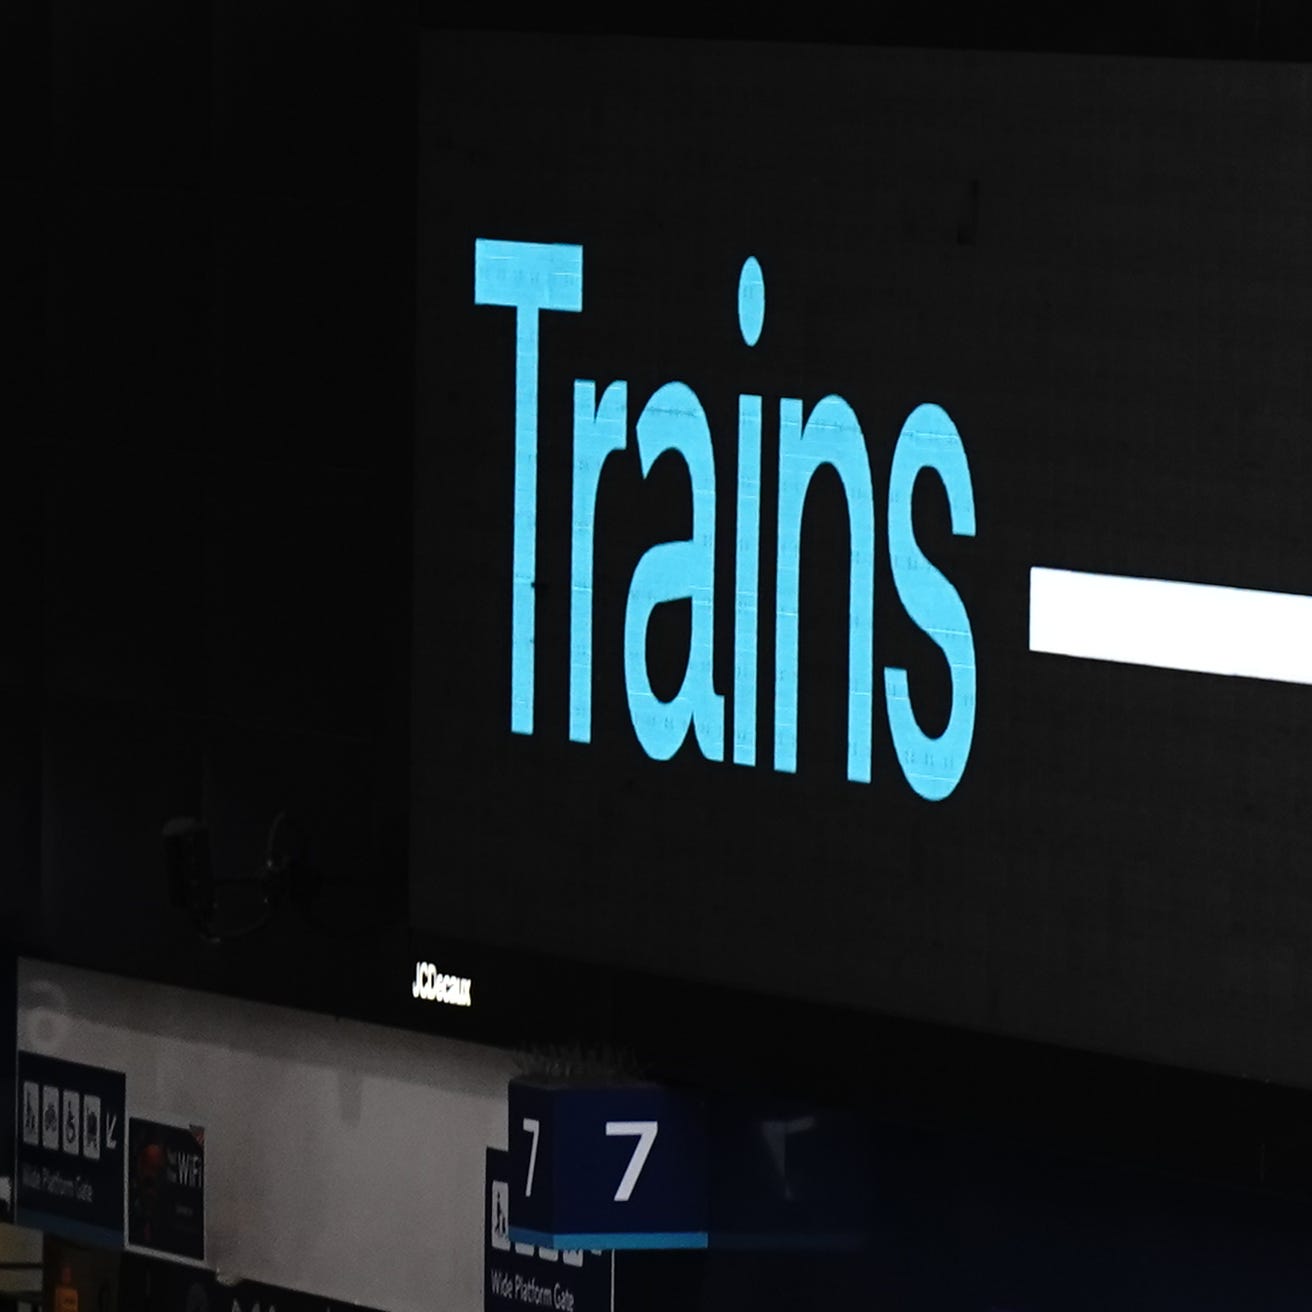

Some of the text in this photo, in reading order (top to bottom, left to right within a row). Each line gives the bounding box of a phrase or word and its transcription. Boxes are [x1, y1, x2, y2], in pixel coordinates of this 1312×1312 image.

[474, 239, 976, 800] Trains
[412, 961, 472, 1007] JCDecaux
[522, 1118, 540, 1197] 7
[605, 1121, 659, 1202] 7
[490, 1268, 575, 1312] Wide Platform Gate
